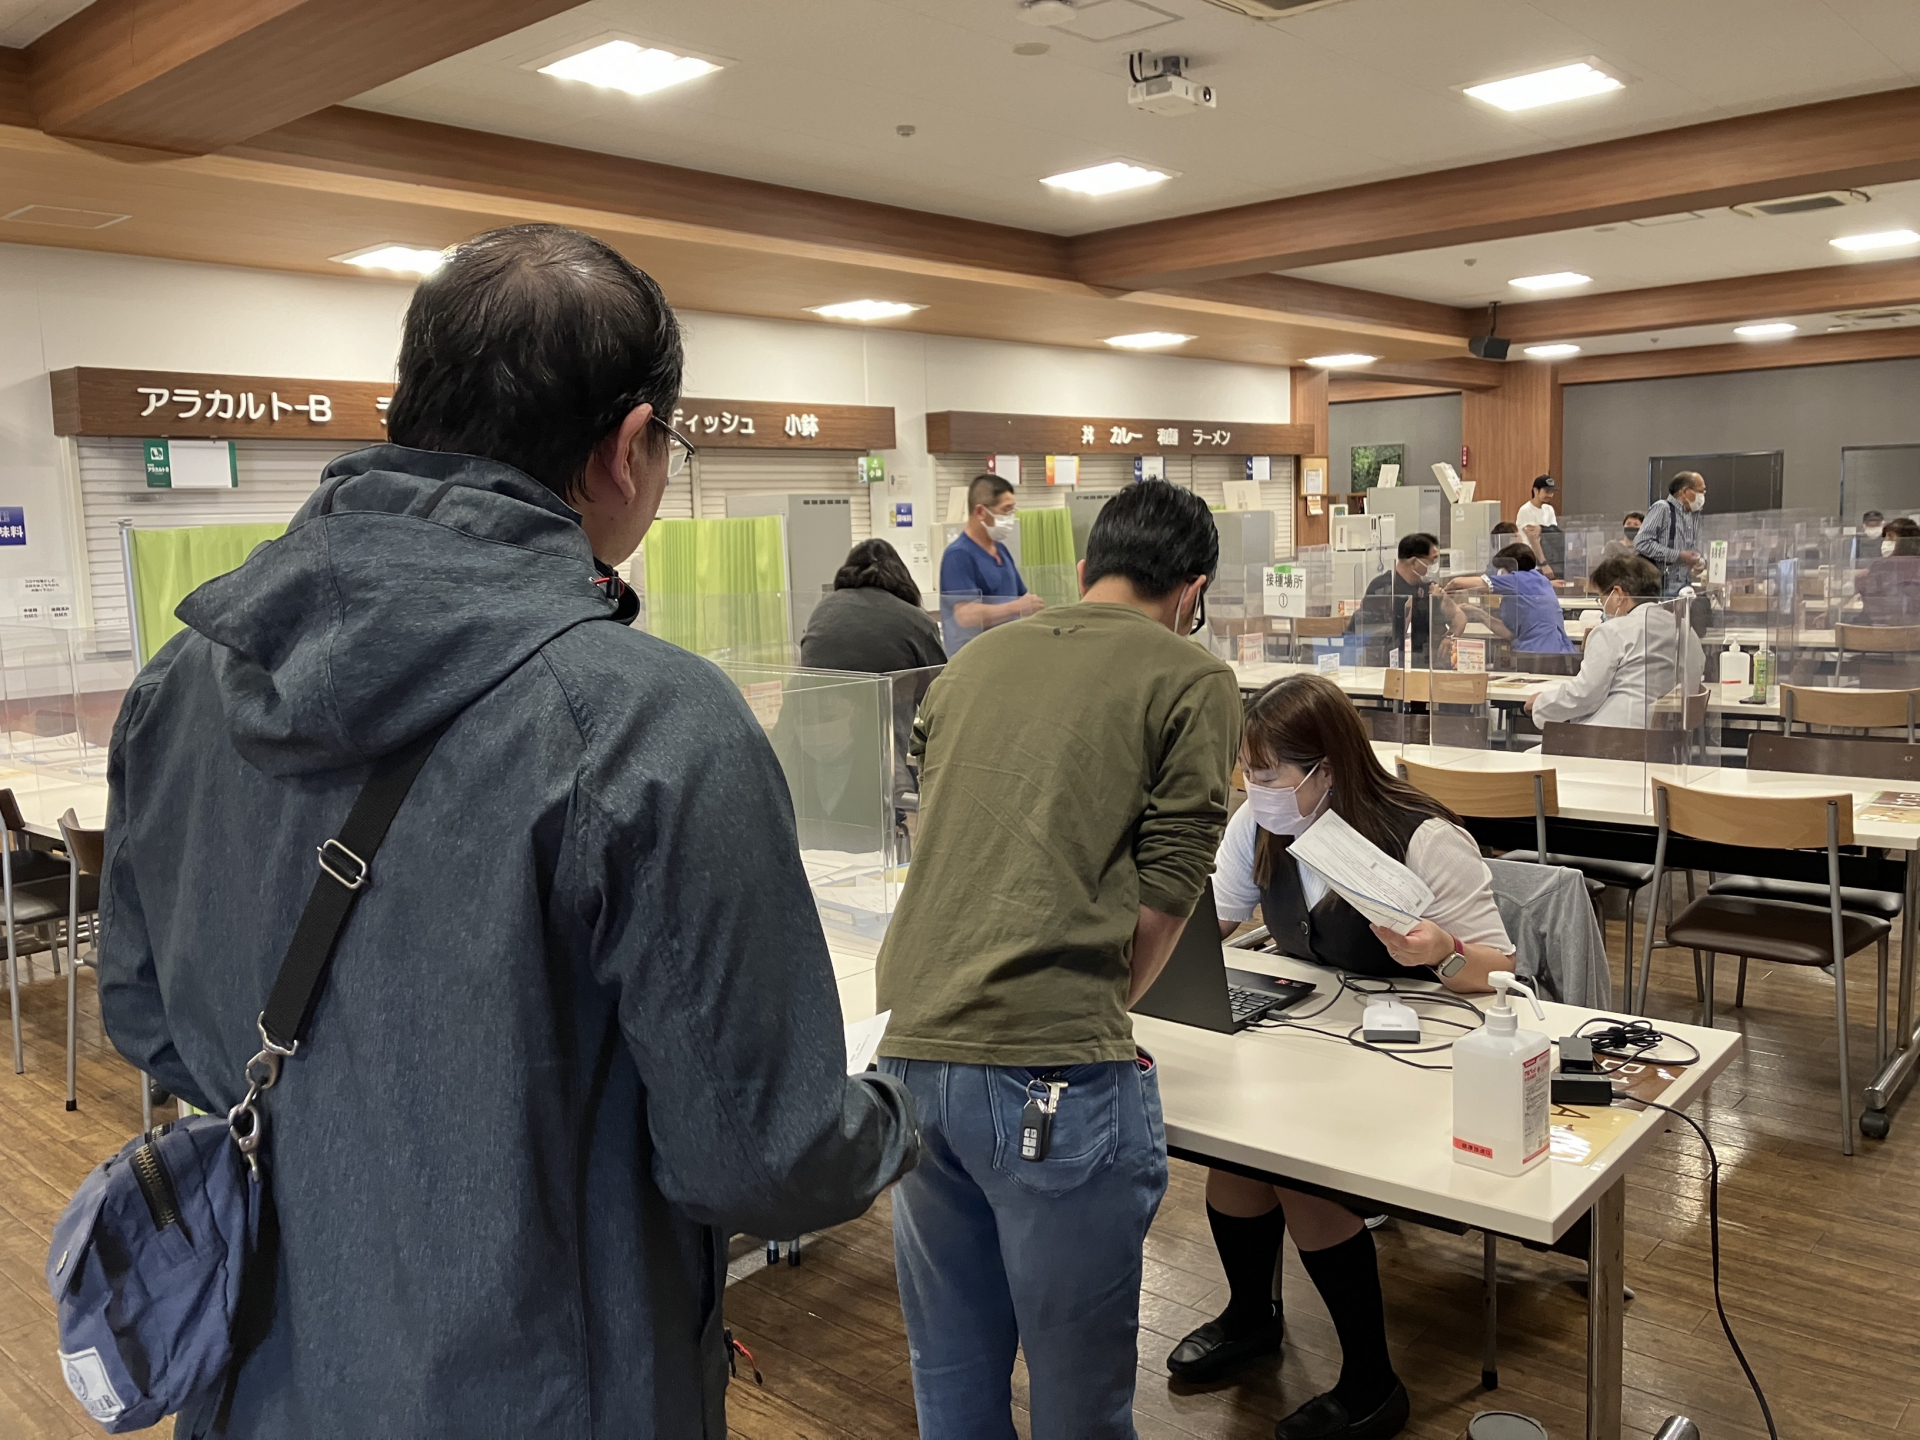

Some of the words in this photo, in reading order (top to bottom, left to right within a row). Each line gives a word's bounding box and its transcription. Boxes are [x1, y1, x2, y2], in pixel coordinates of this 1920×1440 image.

[784, 413, 820, 438] 小鉢
[1081, 425, 1095, 445] 丼
[1109, 426, 1143, 445] カレー
[1192, 429, 1231, 445] ラーメン
[1265, 572, 1304, 590] 接種場所
